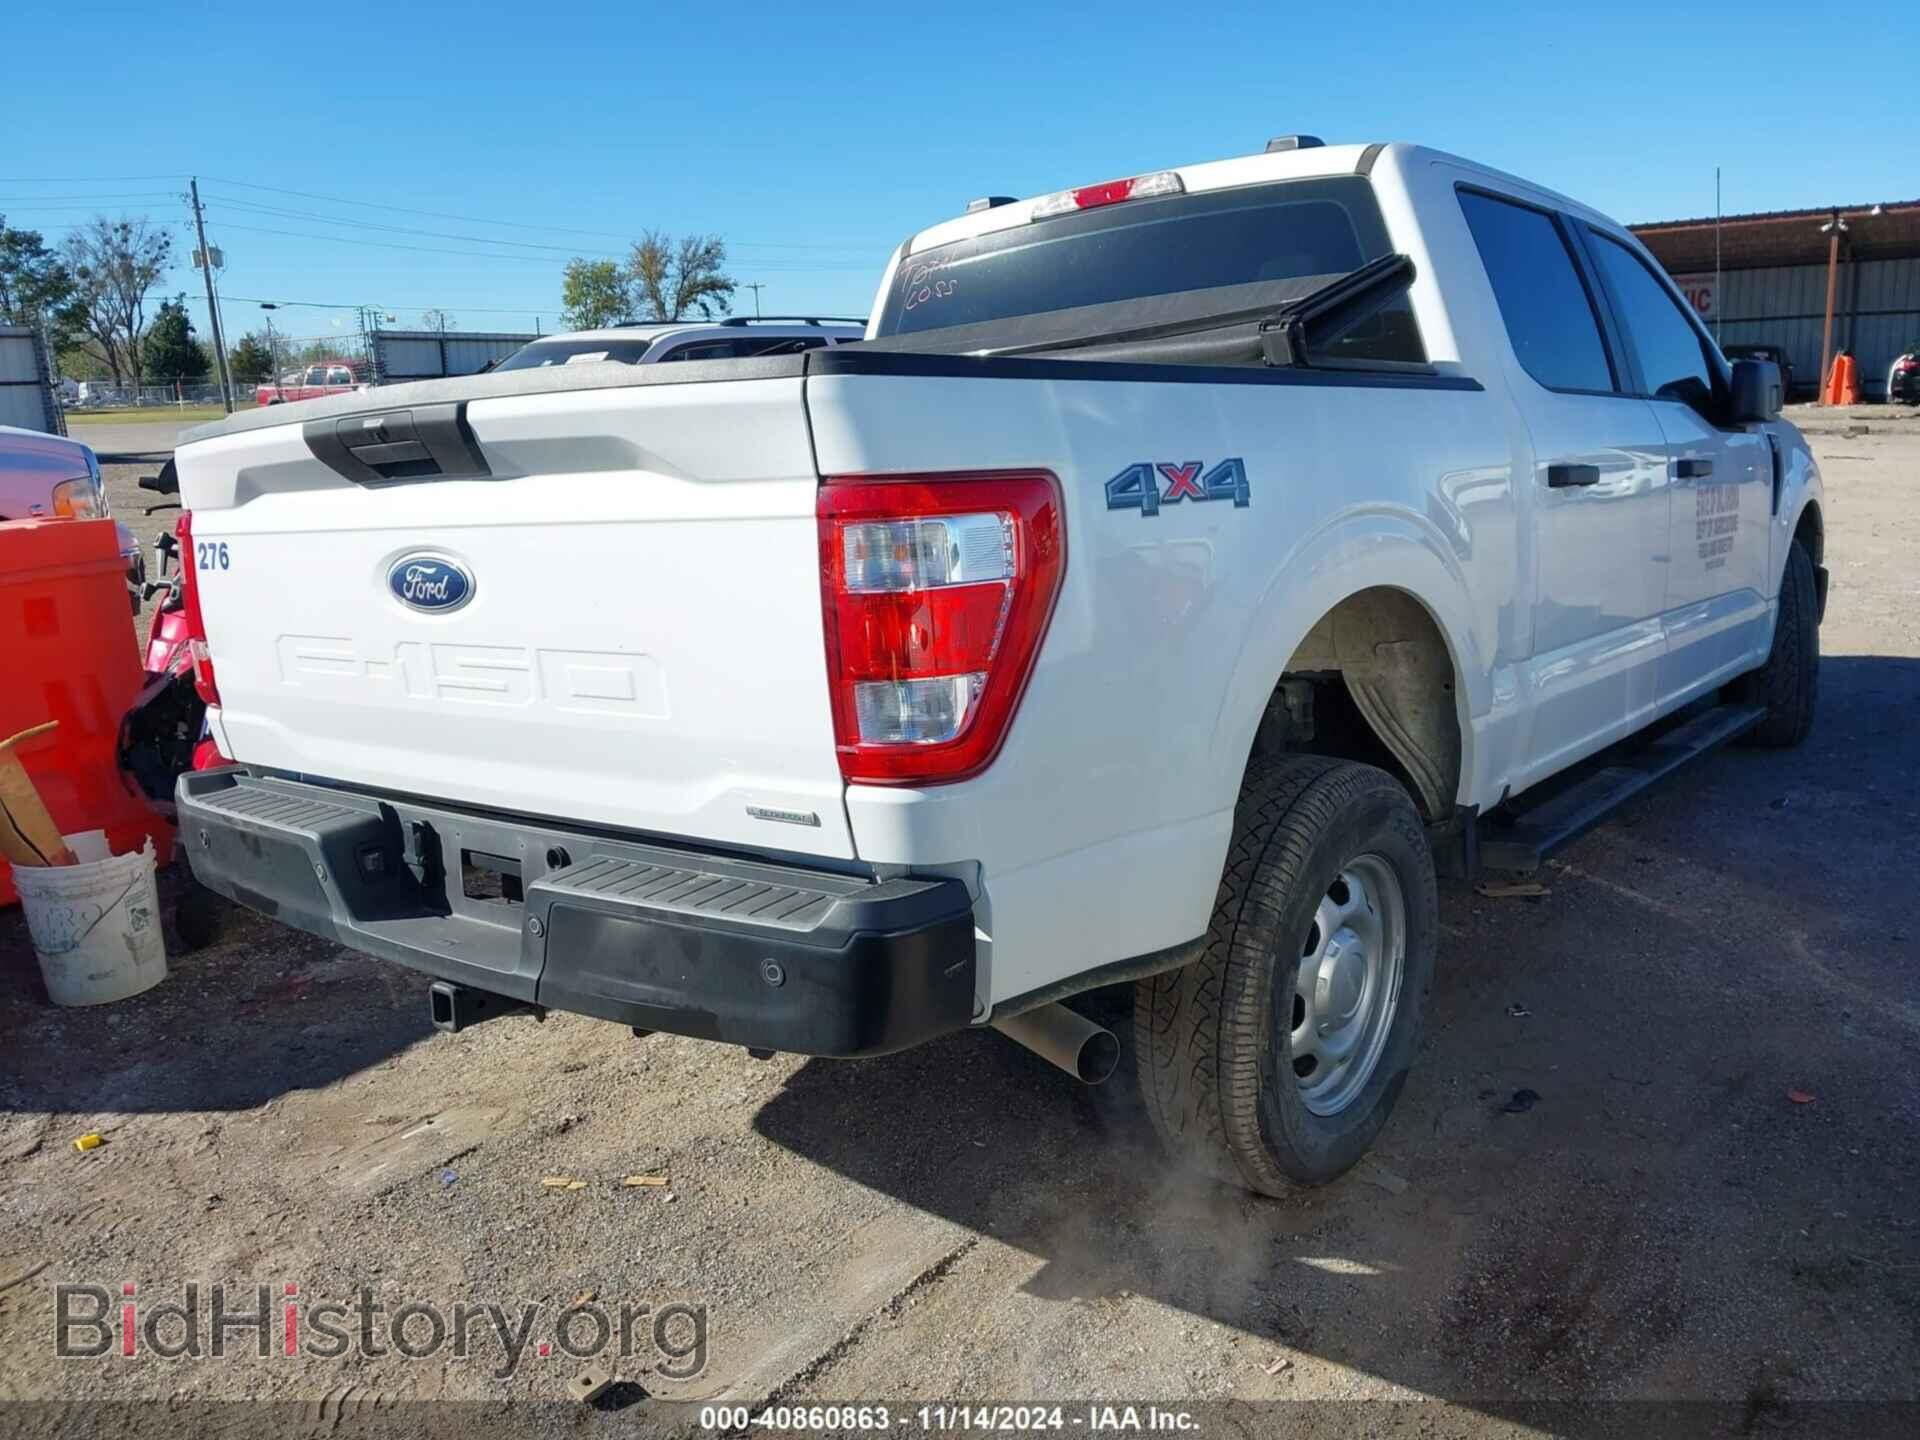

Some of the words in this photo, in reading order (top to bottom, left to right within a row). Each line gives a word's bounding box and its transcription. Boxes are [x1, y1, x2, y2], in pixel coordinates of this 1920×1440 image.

[198, 541, 230, 570] 276
[403, 564, 449, 599] Ford
[276, 633, 672, 719] F-150
